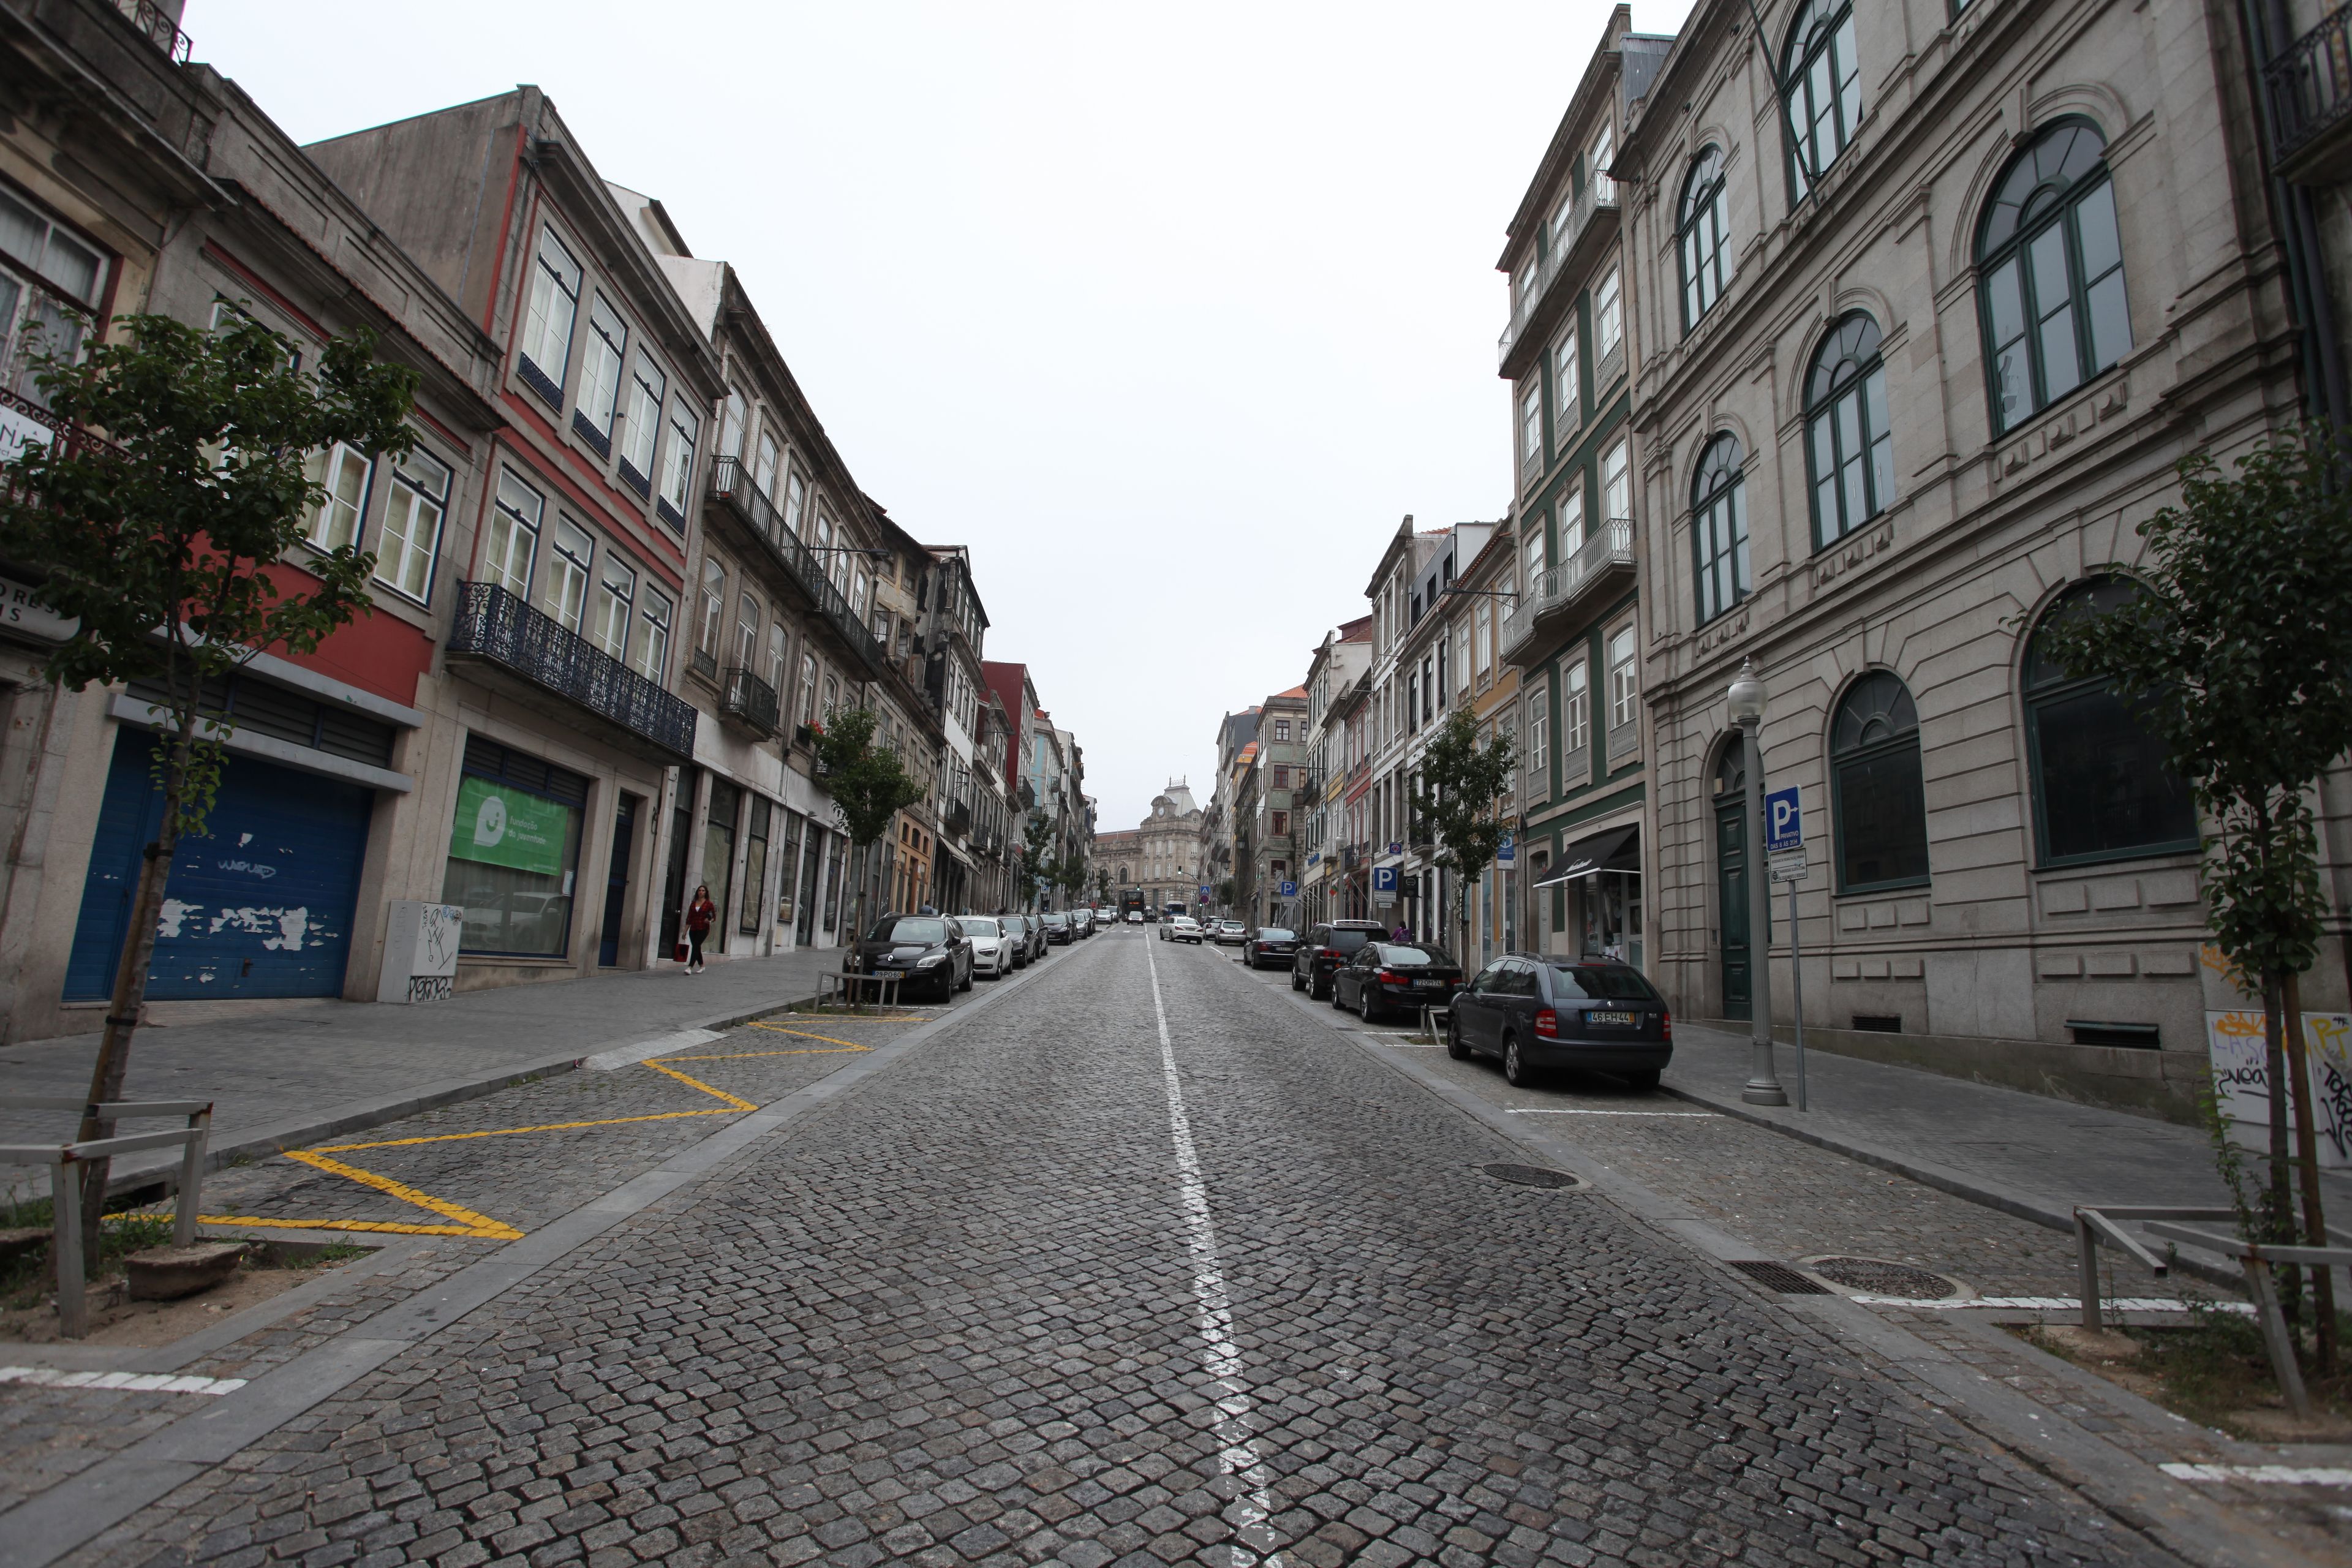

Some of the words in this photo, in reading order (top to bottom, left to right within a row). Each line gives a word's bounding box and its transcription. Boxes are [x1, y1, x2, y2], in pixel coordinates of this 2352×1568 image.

[510, 815, 538, 831] fundação
[1773, 800, 1791, 840] P
[1780, 831, 1799, 839] PRIVATIVO
[1379, 869, 1392, 888] P
[1284, 883, 1292, 894] P
